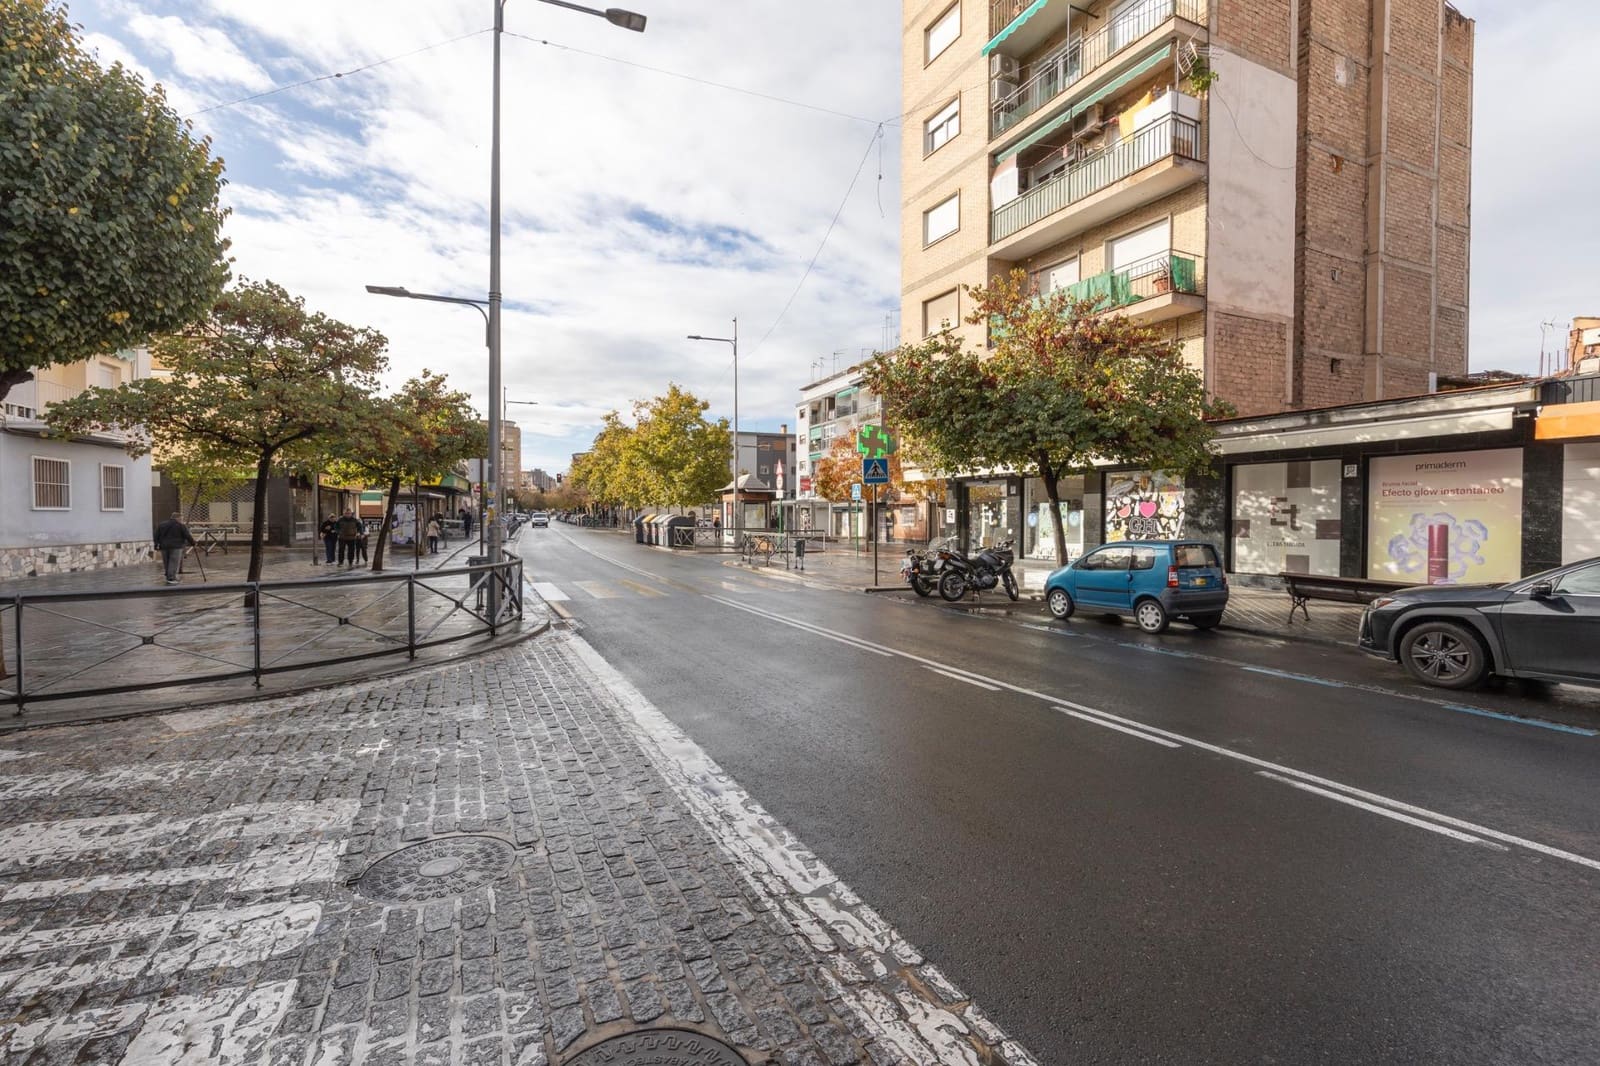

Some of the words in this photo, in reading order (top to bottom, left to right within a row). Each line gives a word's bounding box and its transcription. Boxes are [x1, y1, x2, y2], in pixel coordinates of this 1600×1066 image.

[1415, 460, 1466, 472] primaderm
[1382, 488, 1411, 497] Efecto
[1414, 487, 1438, 498] glow
